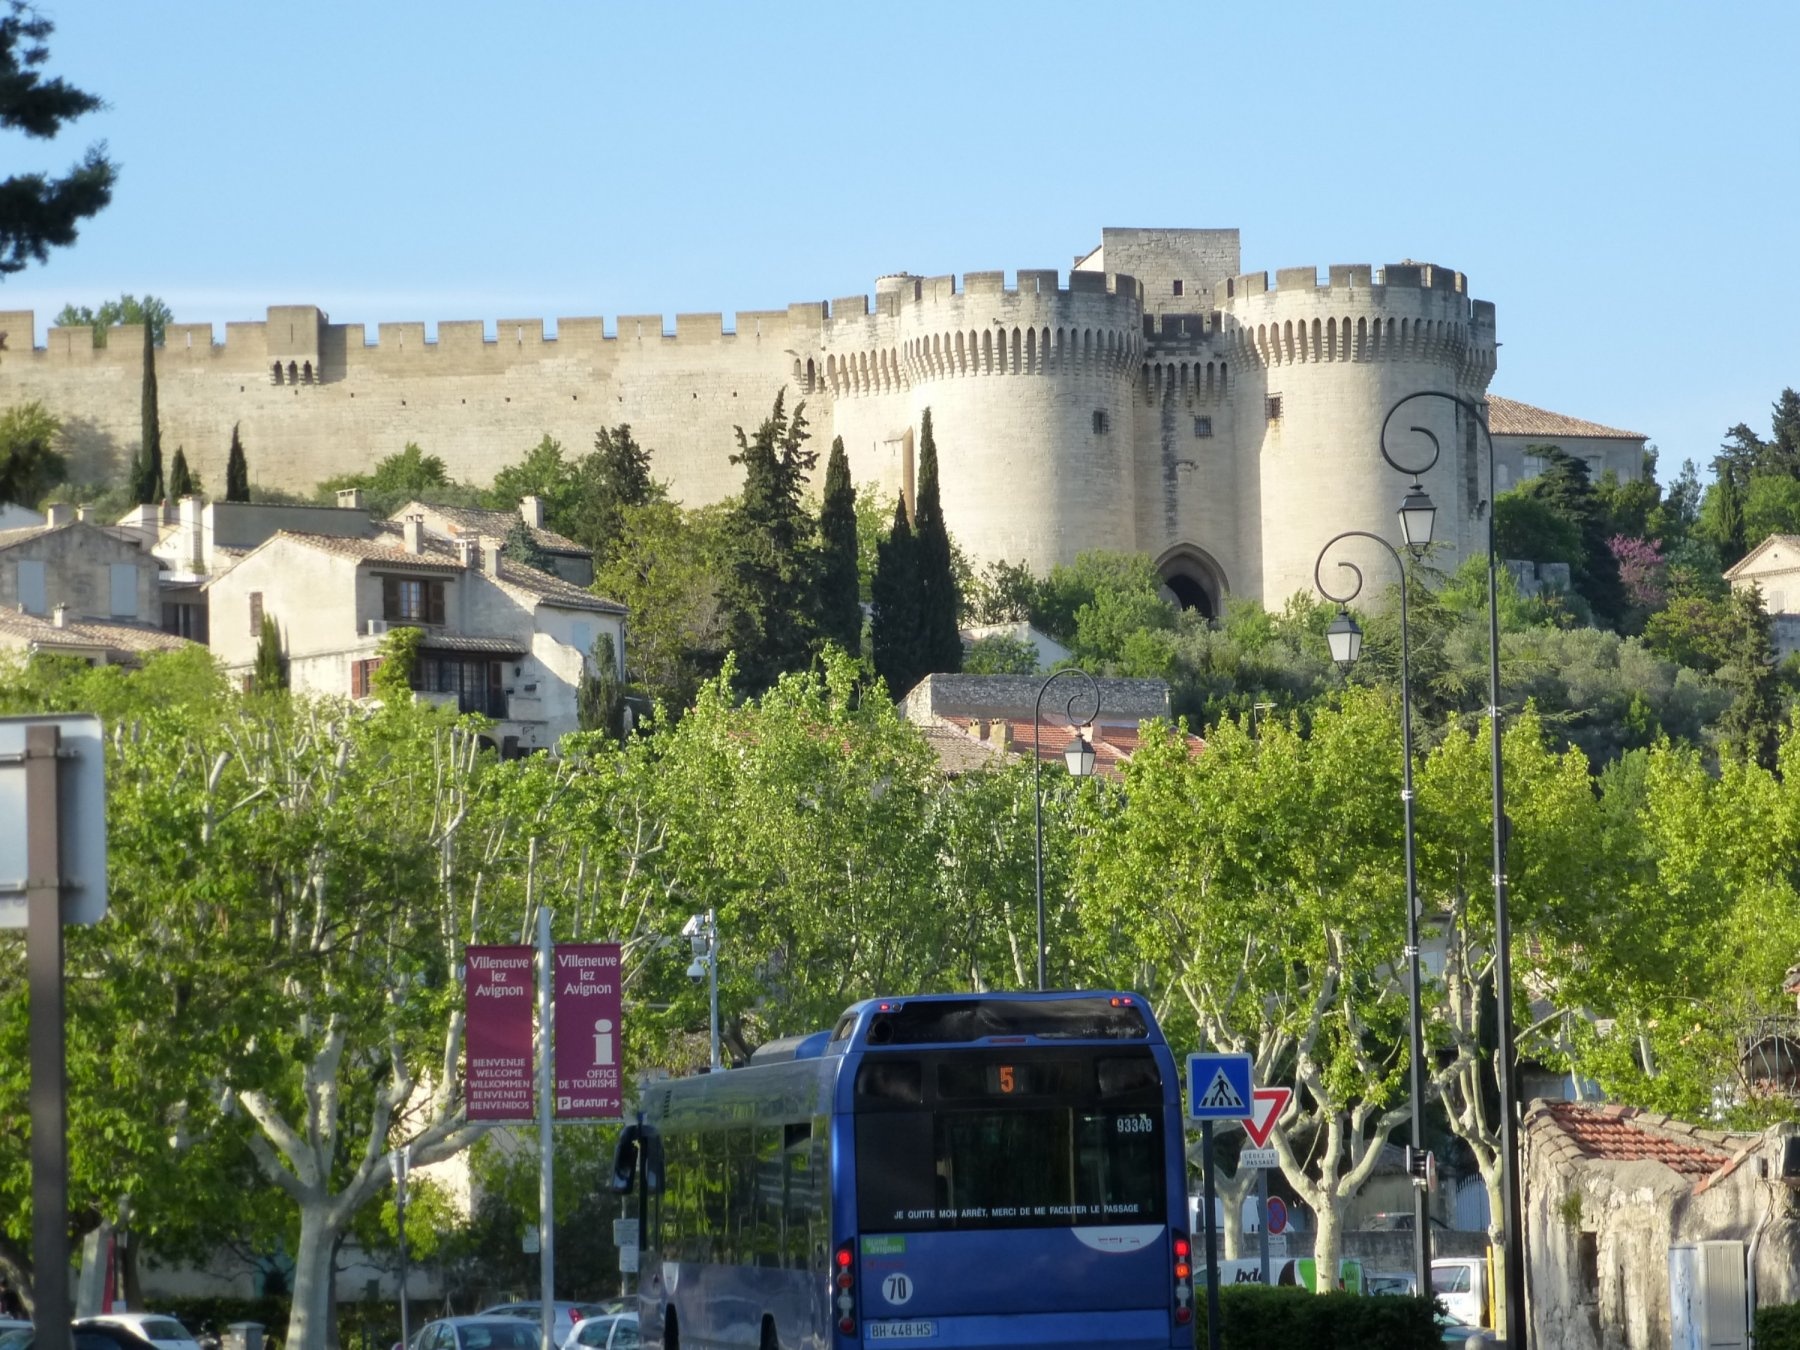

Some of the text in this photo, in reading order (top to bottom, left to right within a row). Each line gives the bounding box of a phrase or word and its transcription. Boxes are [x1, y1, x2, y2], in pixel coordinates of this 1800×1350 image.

[470, 956, 529, 969] Villeneuve
[558, 954, 617, 967] Villeneuve
[491, 970, 507, 982] lez
[580, 968, 595, 981] lez
[475, 984, 524, 998] Avignon
[564, 982, 612, 997] Avignon
[472, 1058, 526, 1068] BIENVENUE
[476, 1069, 523, 1078] WELCOME
[587, 1069, 618, 1079] OFFICE
[1000, 1065, 1014, 1093] 5
[470, 1079, 530, 1089] WILLKOMMEN
[559, 1078, 618, 1089] DE TOURISME
[473, 1090, 527, 1100] BENVENUTI
[470, 1101, 530, 1111] BIENVENIDOS
[572, 1098, 608, 1109] GRATUIT
[1117, 1118, 1153, 1133] 93348
[894, 1210, 904, 1220] JE
[907, 1209, 936, 1220] QUITTE
[939, 1209, 958, 1219] MON
[991, 1207, 1017, 1217] MERCI
[1019, 1207, 1031, 1216] DE
[1034, 1206, 1046, 1216] ME
[1049, 1205, 1087, 1215] FACILITER
[1090, 1205, 1100, 1214] LE
[1103, 1203, 1139, 1213] PASSAGE
[887, 1276, 907, 1301] 70
